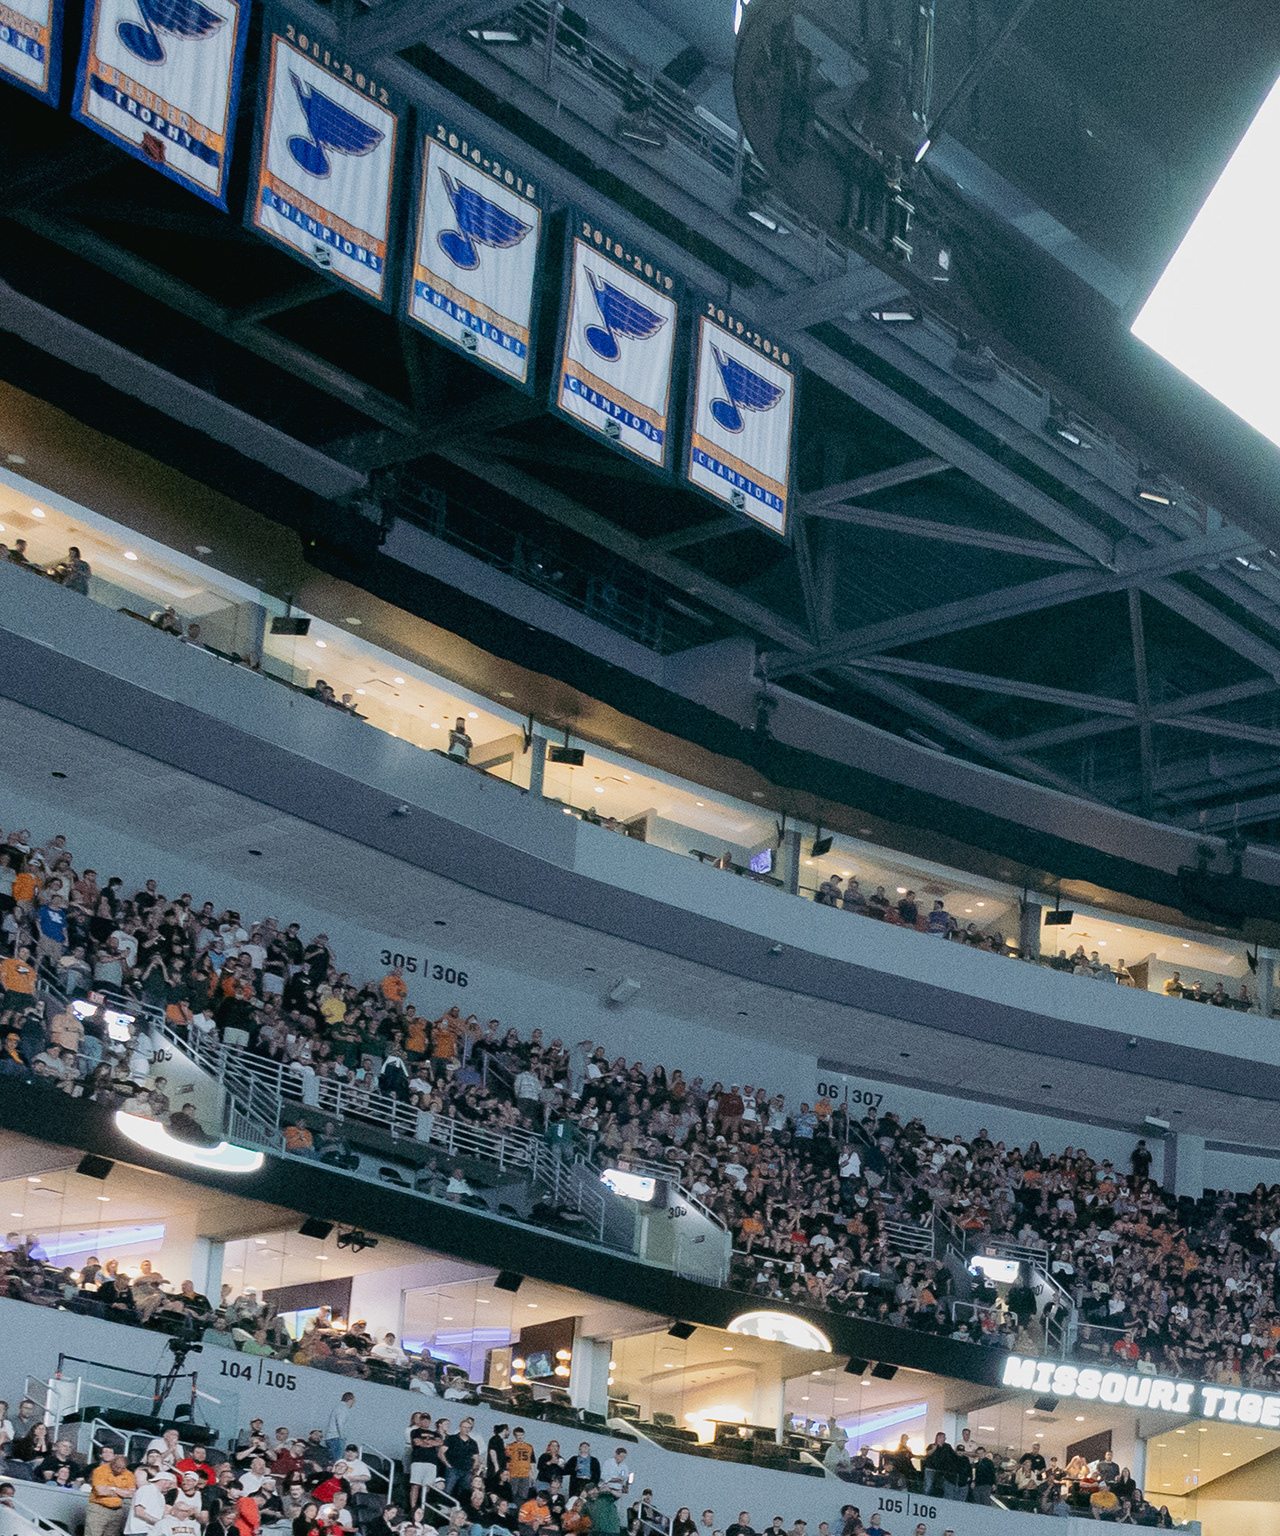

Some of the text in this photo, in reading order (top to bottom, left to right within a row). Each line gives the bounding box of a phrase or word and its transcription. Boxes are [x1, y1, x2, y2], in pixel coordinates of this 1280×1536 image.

[114, 90, 193, 148] TROPHY
[270, 194, 379, 270] CHAMPIONS
[422, 285, 521, 354] CHAMPIONS
[568, 378, 660, 441] CHAMPIONS
[697, 452, 783, 510] CHAMPIONS
[380, 949, 469, 988] 305 306
[816, 1082, 884, 1108] 06 307
[219, 1359, 297, 1391] 104 105
[1002, 1355, 1196, 1414] MISSOURI
[877, 1497, 937, 1519] 105 106
